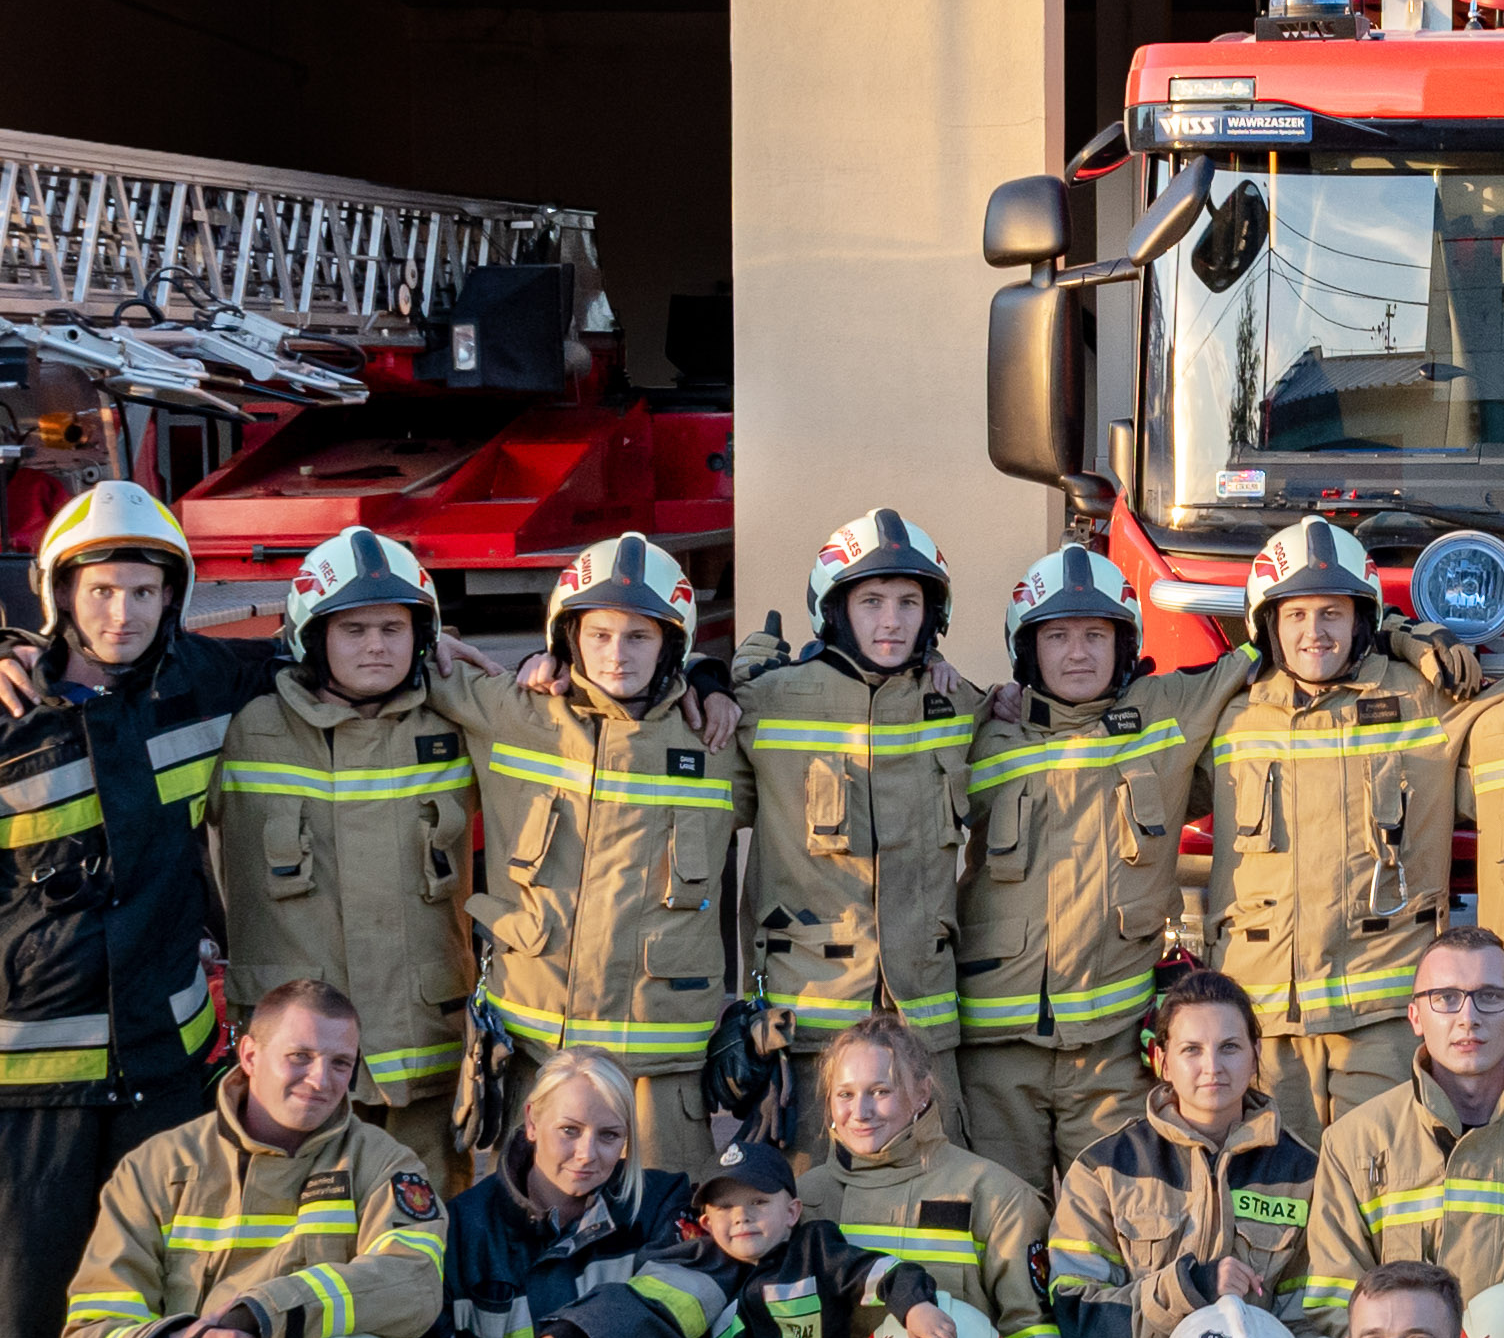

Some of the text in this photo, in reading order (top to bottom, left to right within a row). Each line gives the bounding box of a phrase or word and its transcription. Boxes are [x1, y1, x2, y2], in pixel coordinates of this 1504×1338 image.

[1158, 116, 1215, 135] WISS
[1227, 116, 1305, 128] WAWRZASZEK
[318, 559, 338, 587] IREK
[1031, 572, 1046, 599] BAZA
